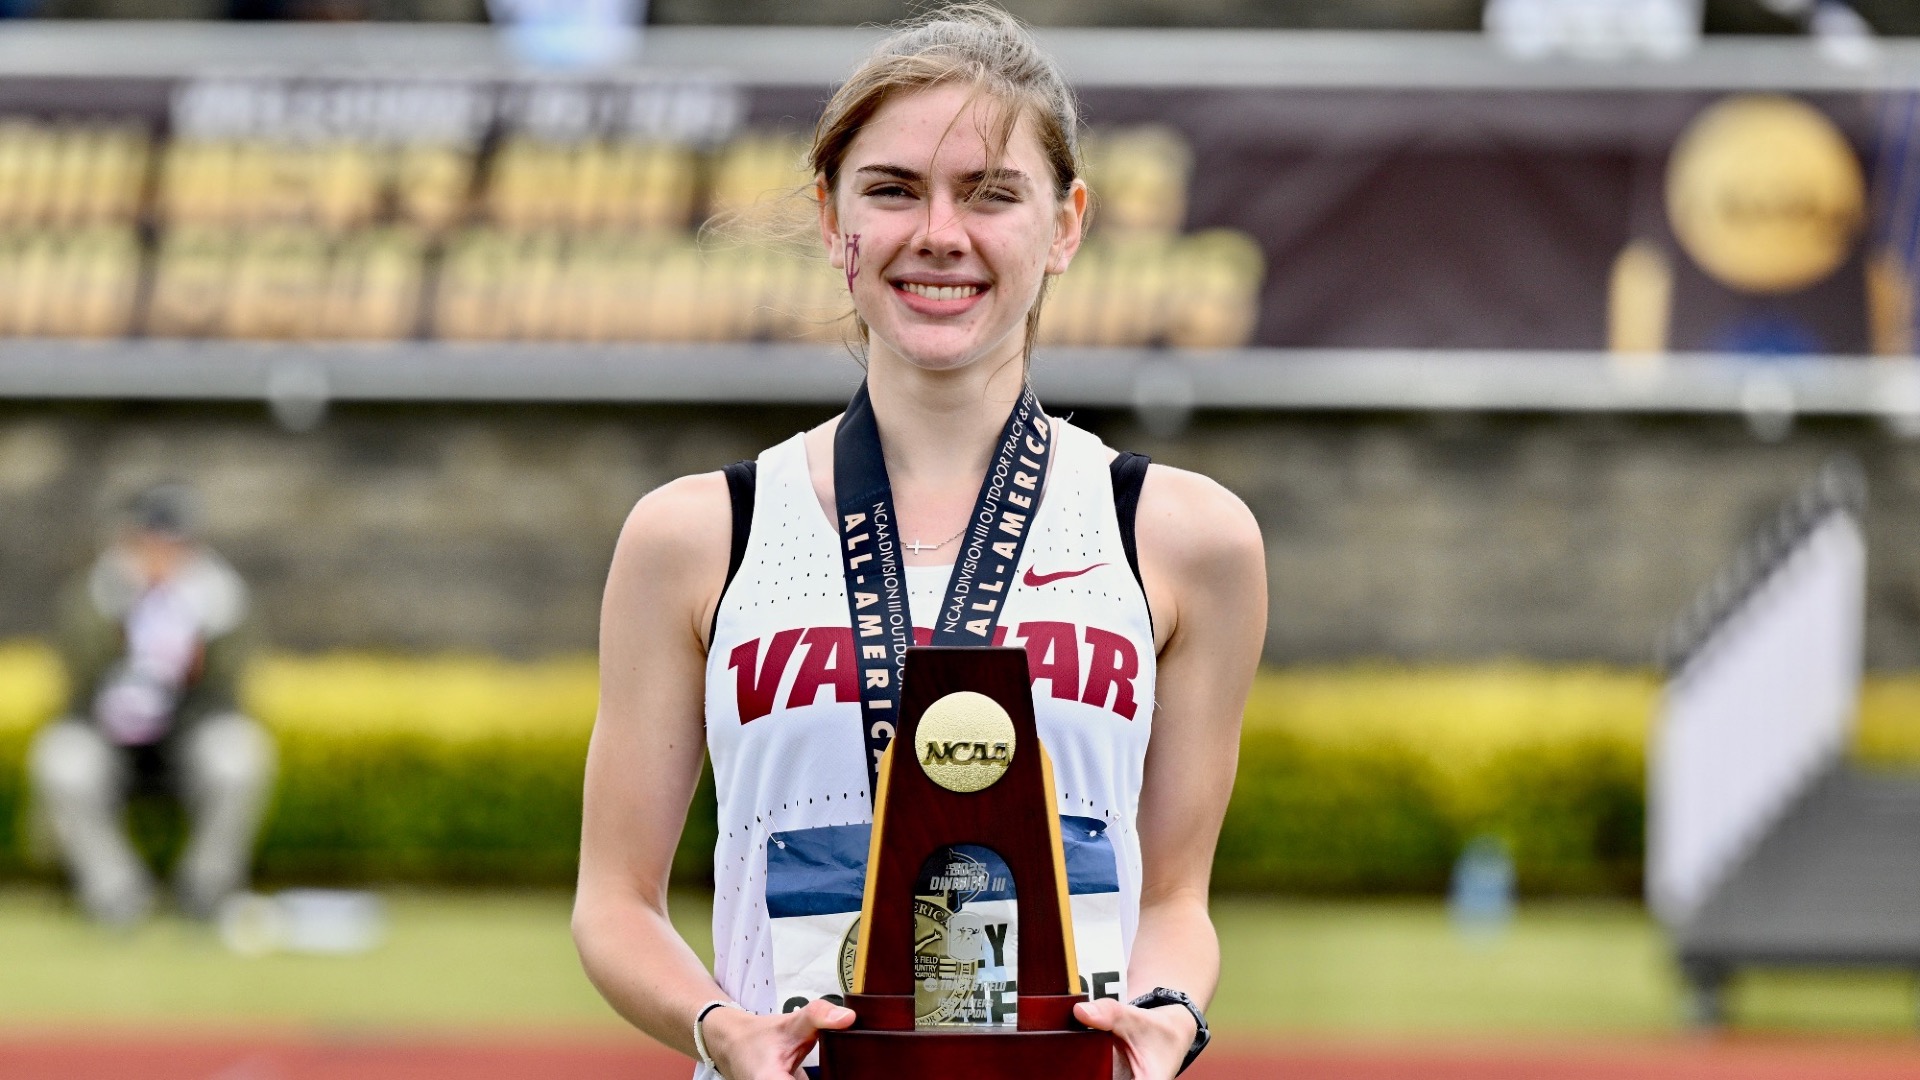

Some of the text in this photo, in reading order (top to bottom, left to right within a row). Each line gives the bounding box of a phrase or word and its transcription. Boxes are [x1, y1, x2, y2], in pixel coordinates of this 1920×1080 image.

[943, 386, 1033, 633] NCAA DIVISION III OUTDOOR TRACK & FIEL
[872, 502, 907, 690] NCAA DIVISION III OUTDOO
[728, 621, 1139, 726] VAAR
[922, 740, 1010, 766] NCAA
[929, 876, 1006, 892] DIVISION III
[919, 955, 939, 964] FIELD
